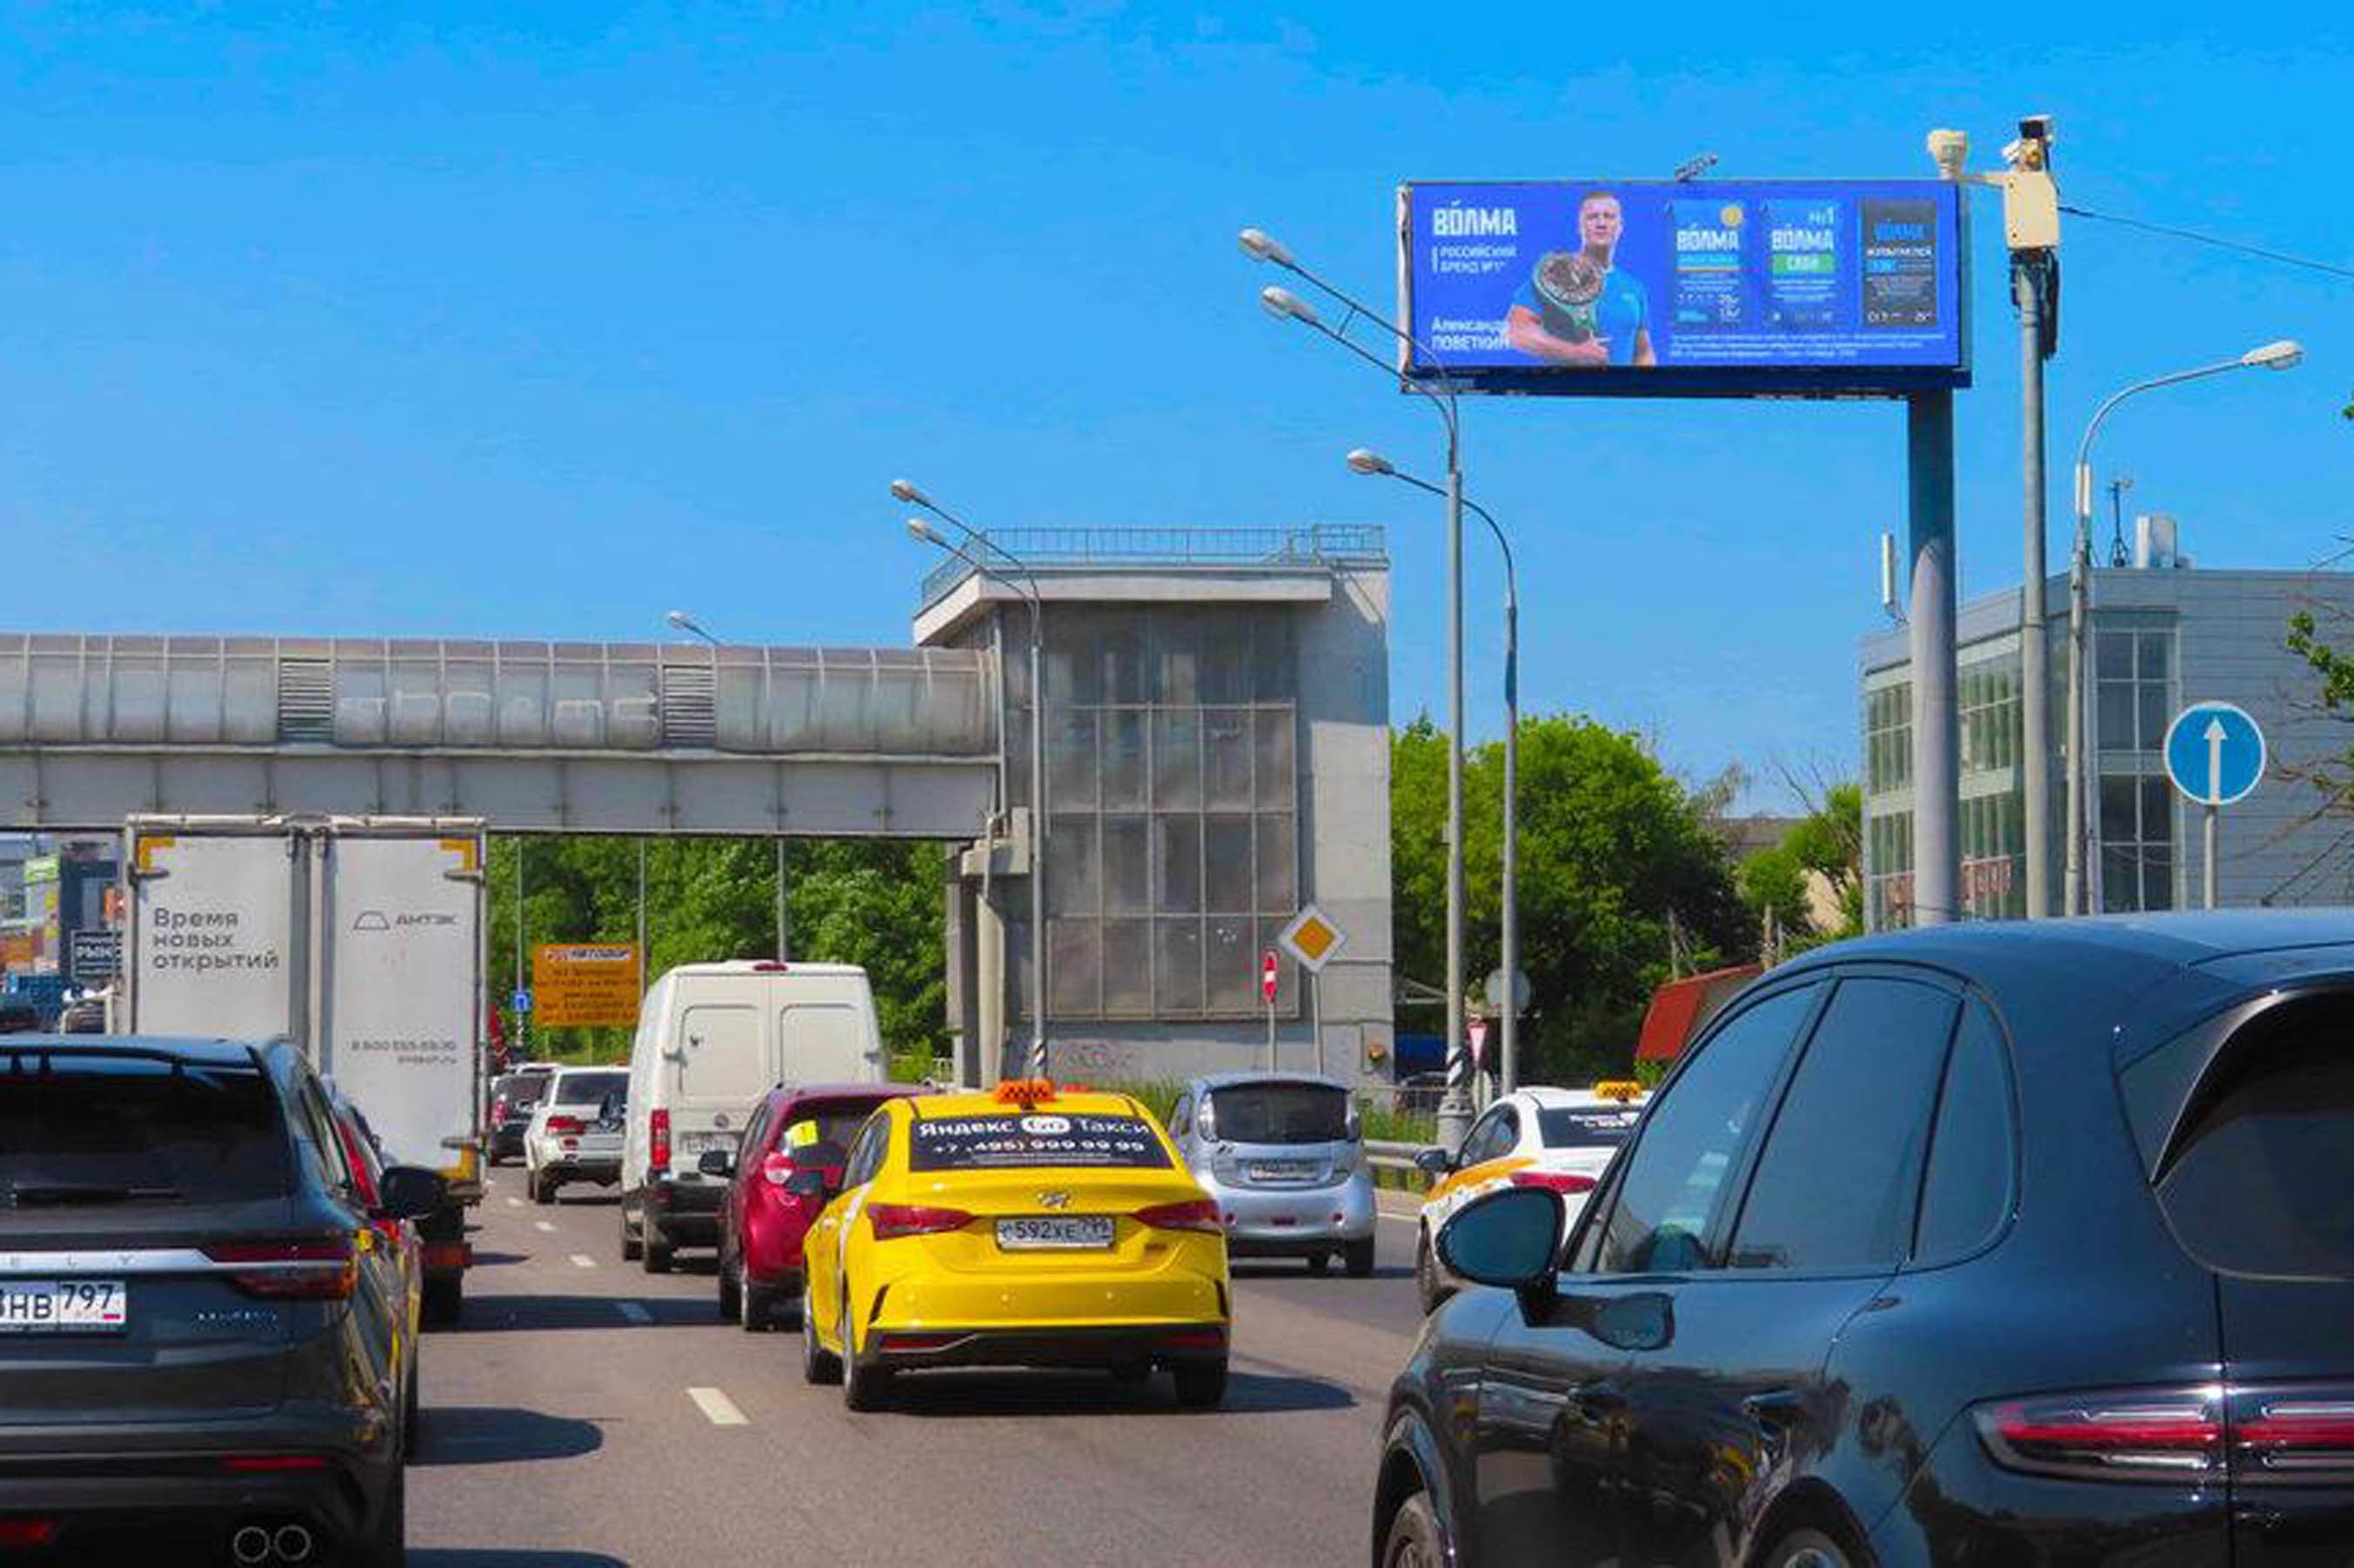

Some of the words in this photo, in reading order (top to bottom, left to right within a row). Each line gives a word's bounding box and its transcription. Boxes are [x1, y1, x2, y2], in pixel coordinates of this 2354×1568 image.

[155, 908, 237, 929] Время
[154, 934, 233, 947] новых
[153, 950, 279, 973] открытий
[920, 1120, 1015, 1138] Яндекс
[1075, 1118, 1150, 1133] Такси
[61, 1284, 115, 1311] 797
